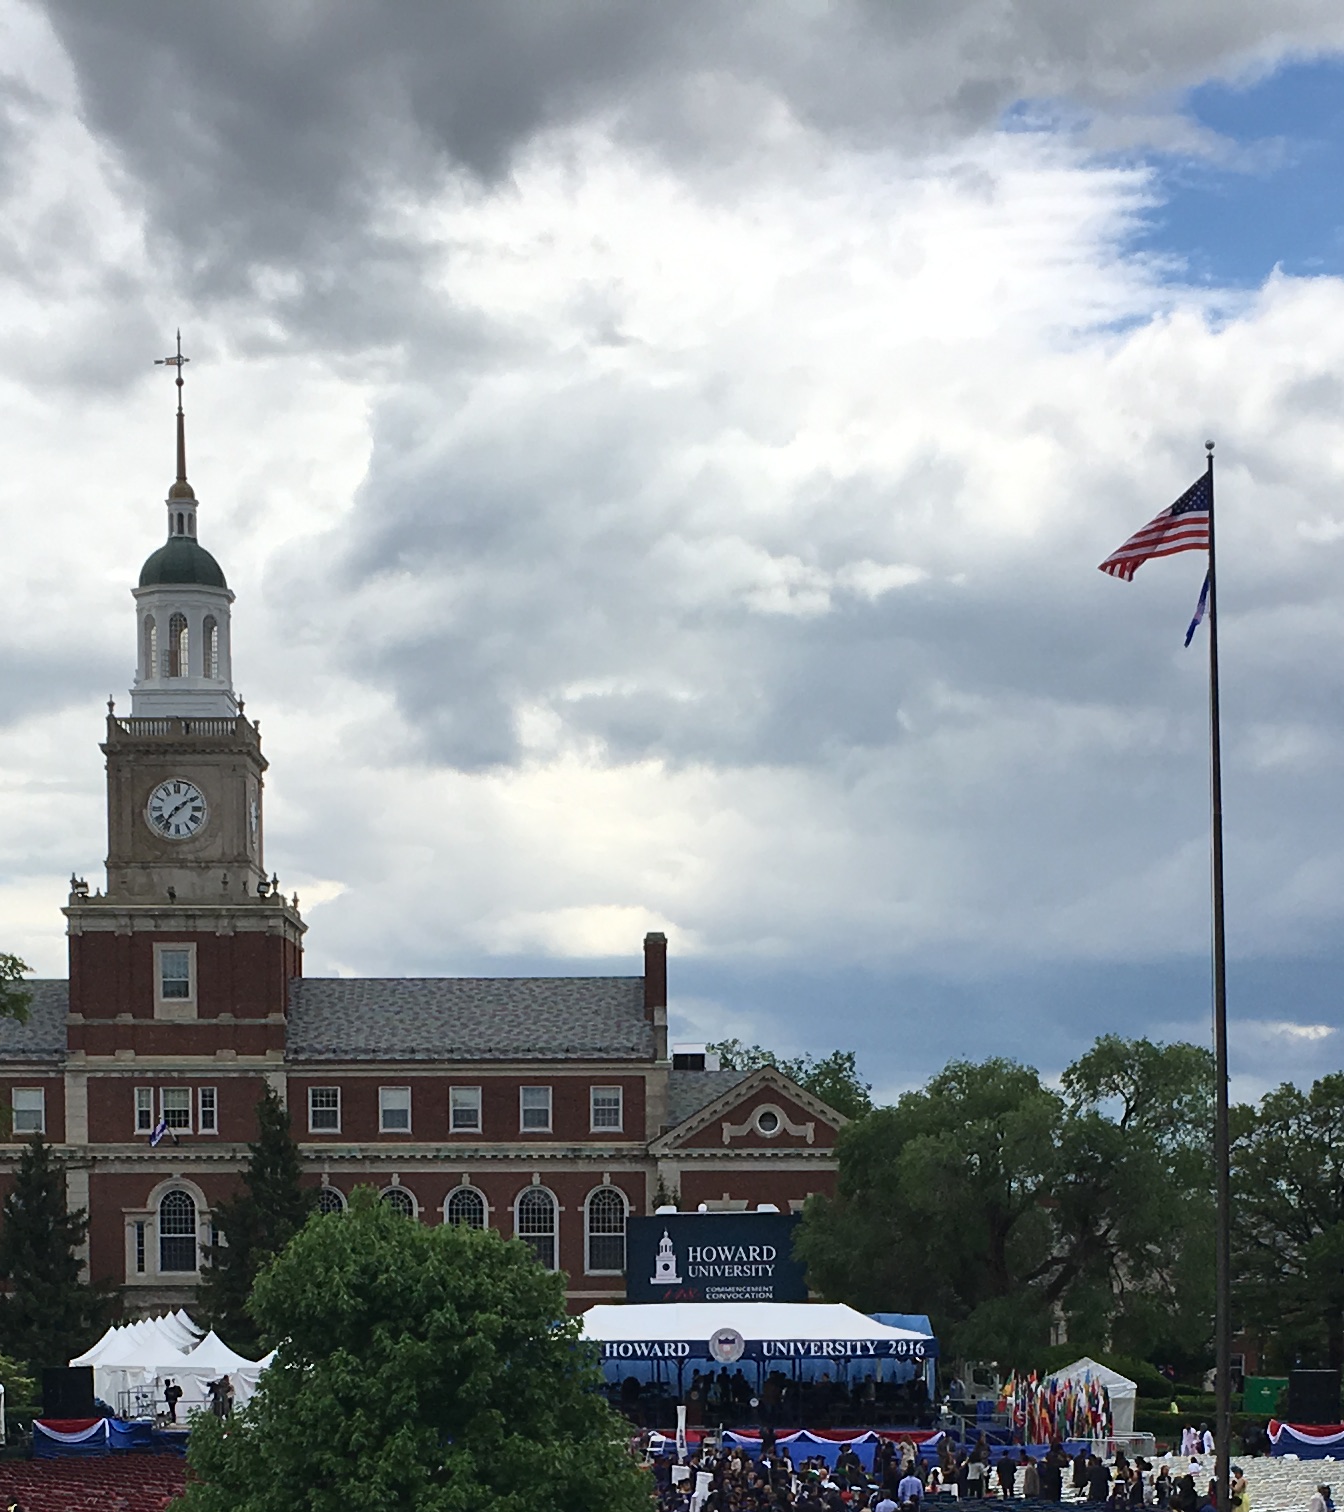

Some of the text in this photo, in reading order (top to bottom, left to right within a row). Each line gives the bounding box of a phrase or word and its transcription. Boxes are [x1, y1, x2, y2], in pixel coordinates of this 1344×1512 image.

[688, 1245, 777, 1262] HOWARD
[688, 1264, 775, 1278] UNIVERSITY
[705, 1292, 774, 1300] CONVOCATION
[605, 1340, 925, 1357] HOWARD UNIVERSITY 2016
